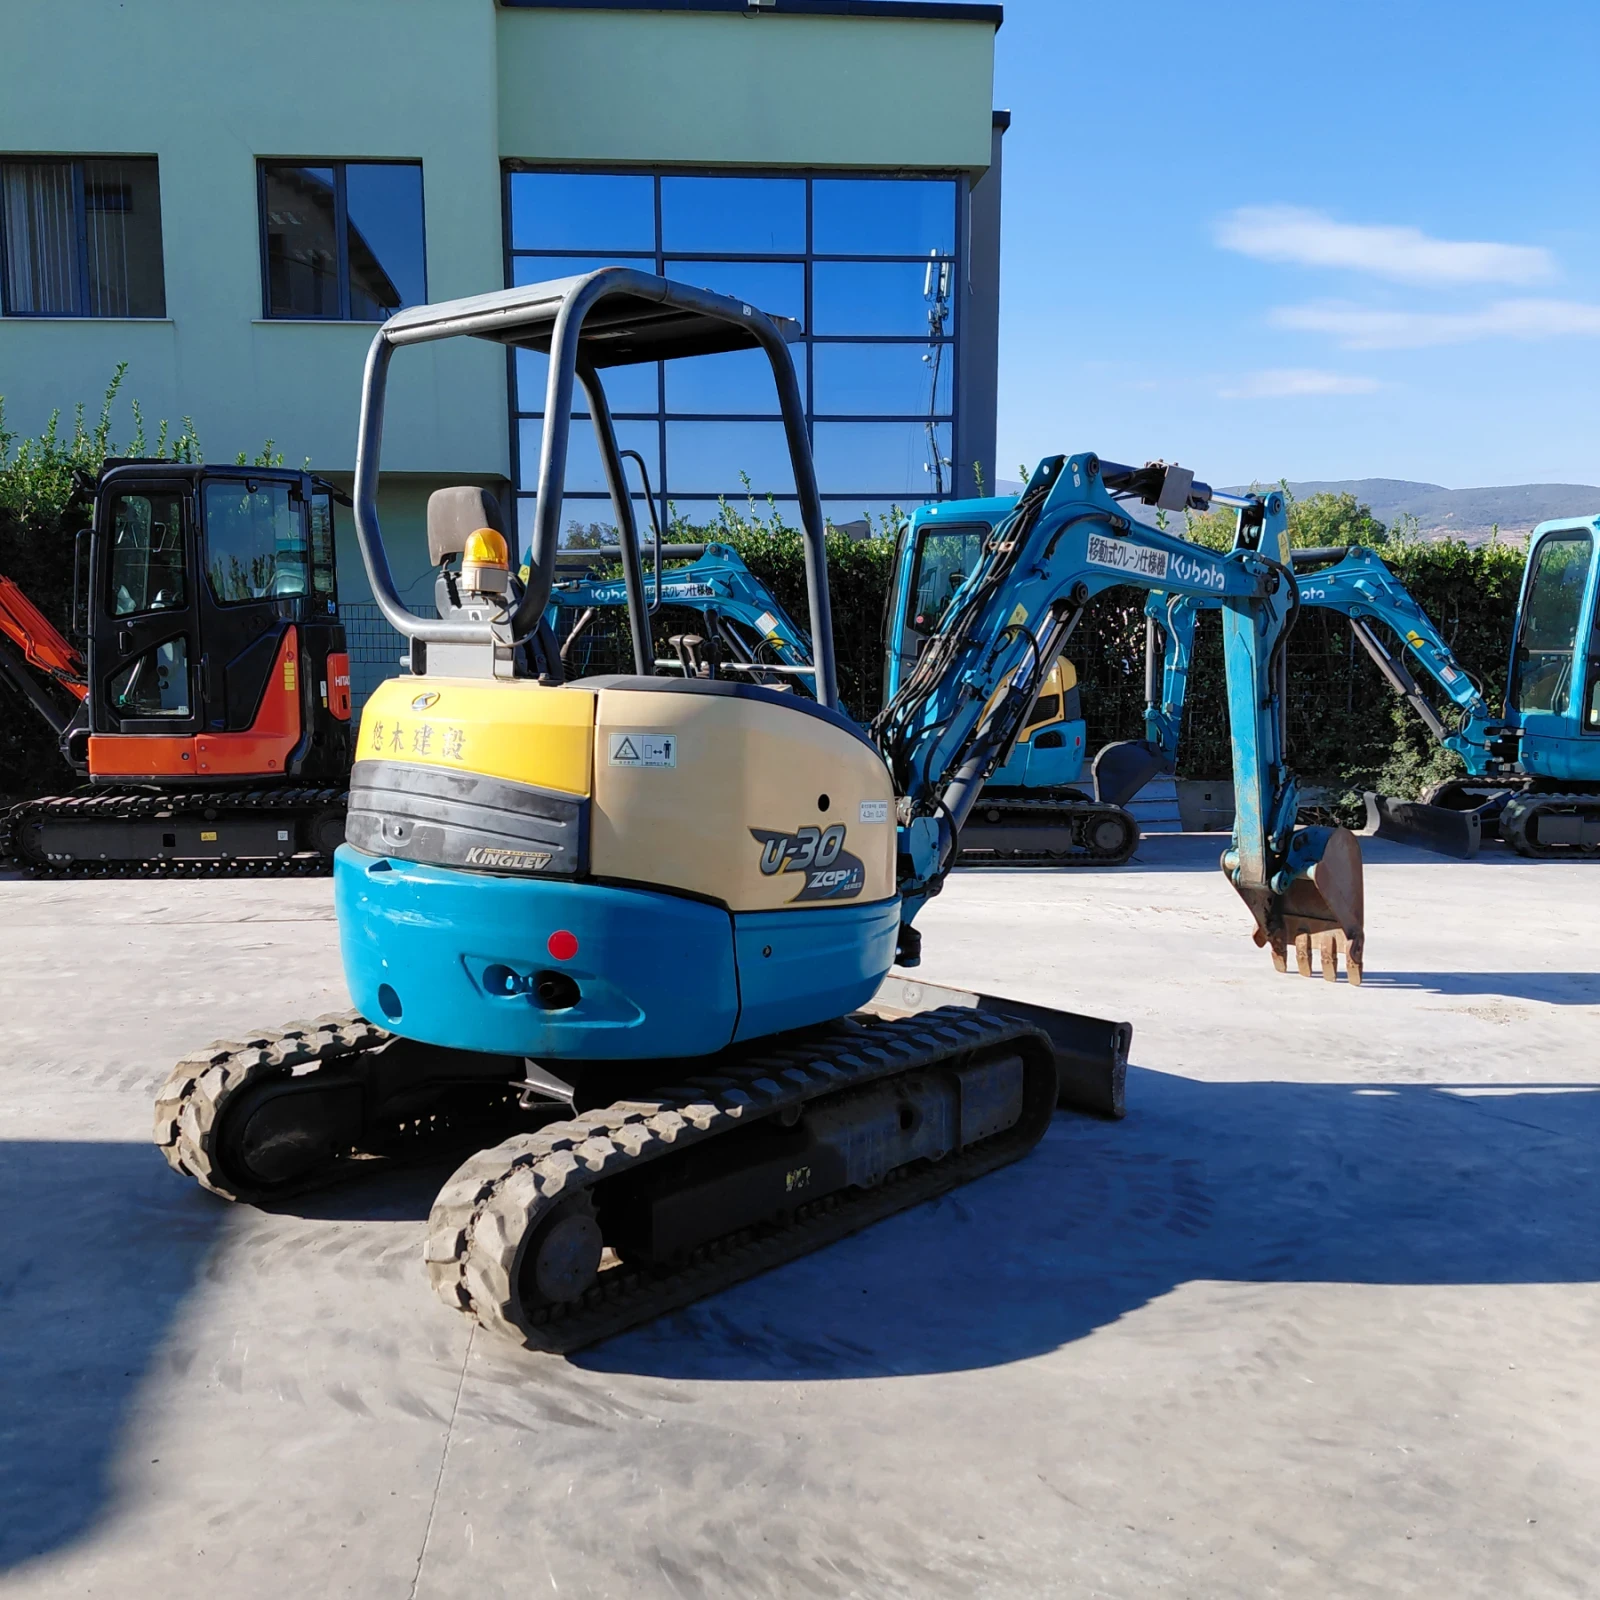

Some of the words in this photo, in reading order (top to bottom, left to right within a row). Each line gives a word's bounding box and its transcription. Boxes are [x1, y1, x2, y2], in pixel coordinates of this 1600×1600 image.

[1170, 552, 1225, 591] Kubota
[465, 847, 552, 870] KINGLEV
[760, 824, 846, 876] U-30
